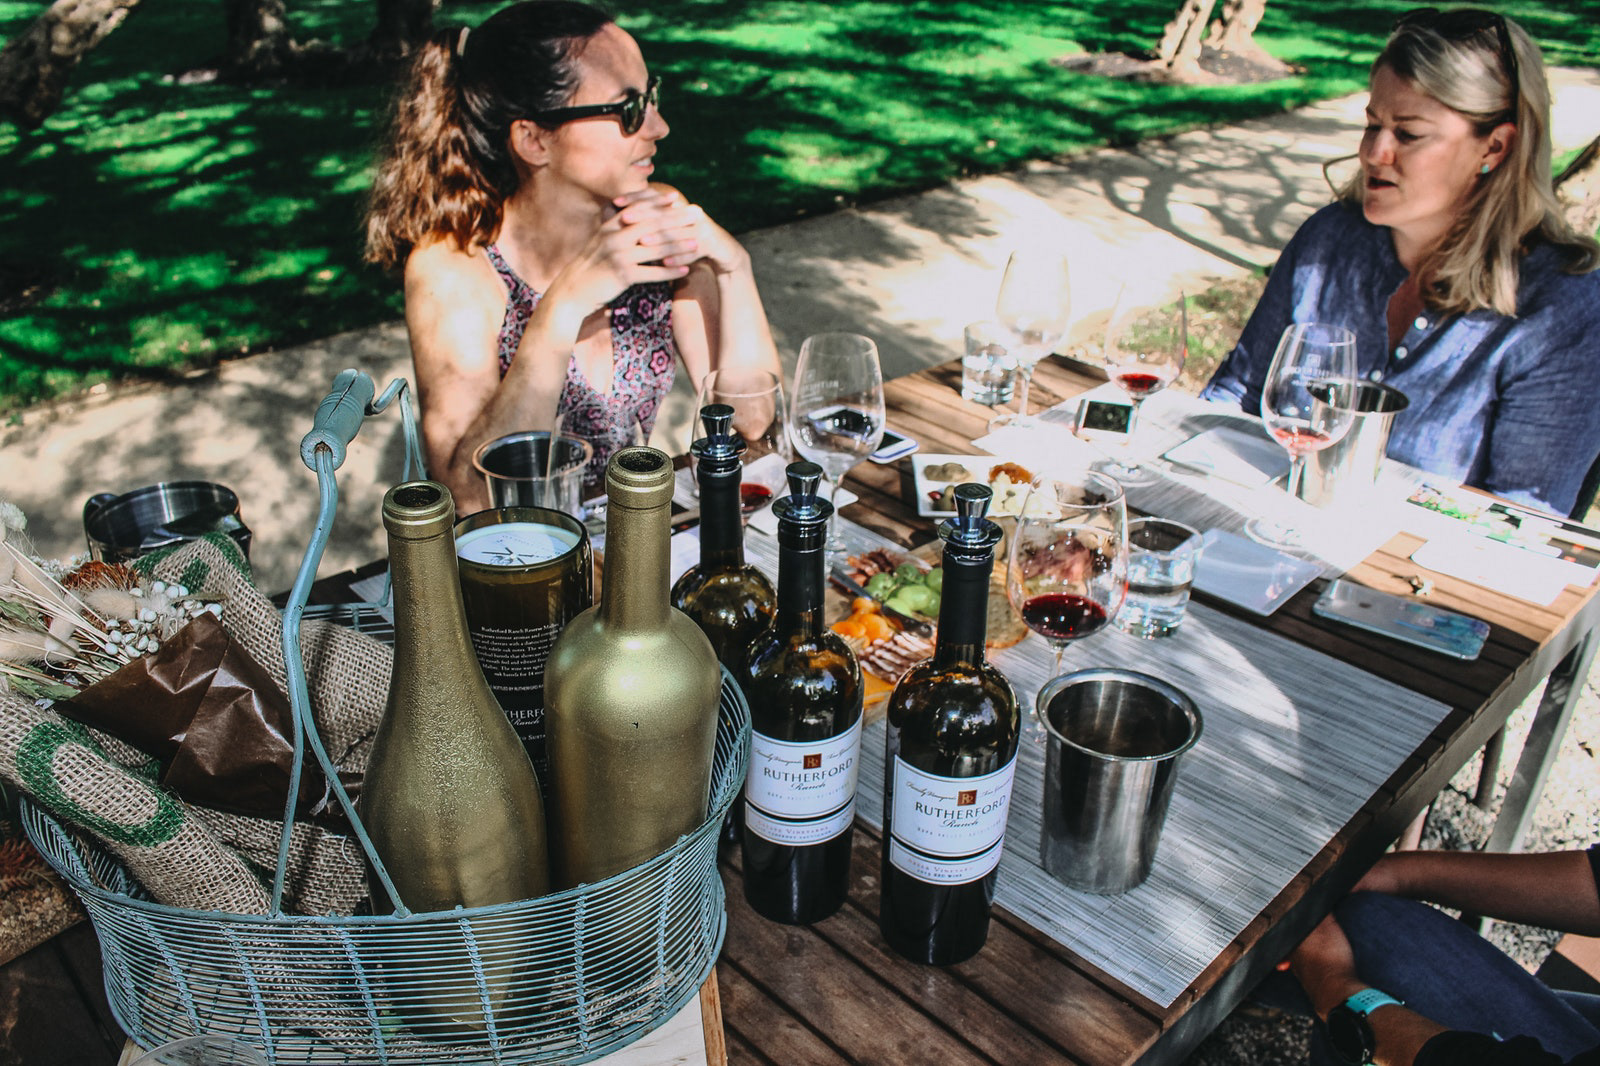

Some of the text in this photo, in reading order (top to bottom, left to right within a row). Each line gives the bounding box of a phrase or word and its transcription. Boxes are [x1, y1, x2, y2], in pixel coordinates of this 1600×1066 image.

[481, 625, 507, 634] Rutherford
[511, 714, 542, 726] Ranch
[763, 758, 853, 782] RUTHERFORD
[791, 782, 826, 791] Ranch
[915, 795, 1006, 820] RUTHERFORD
[940, 818, 980, 828] Ranch
